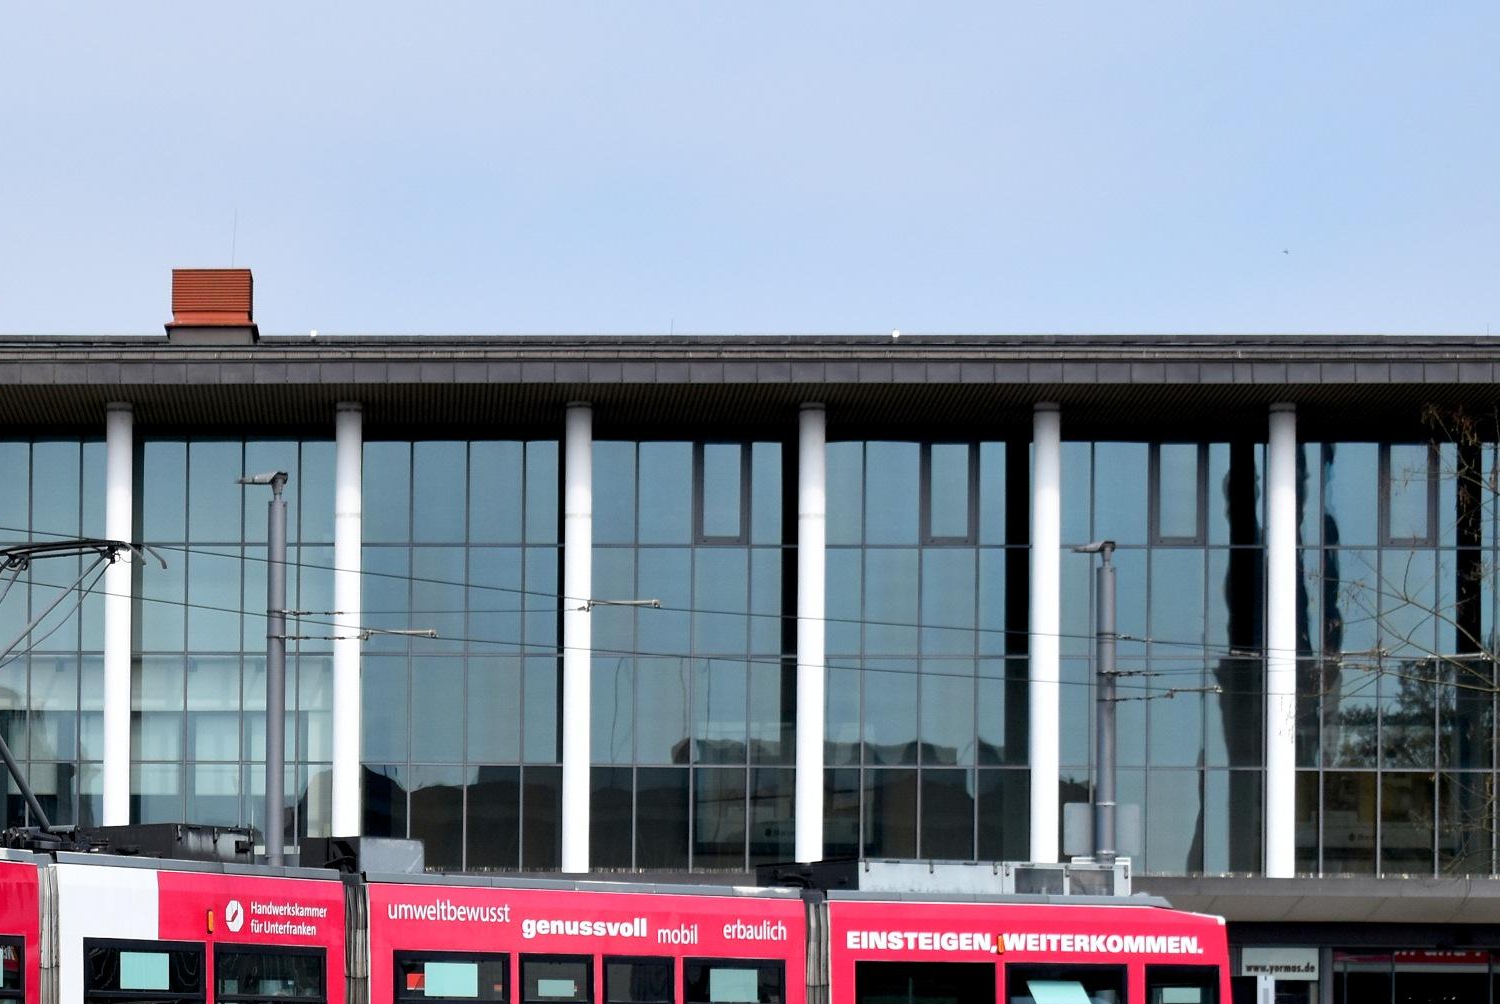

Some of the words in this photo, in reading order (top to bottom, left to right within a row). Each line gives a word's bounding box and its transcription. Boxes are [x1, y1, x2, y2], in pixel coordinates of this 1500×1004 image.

[251, 901, 327, 918] Handwerkskammer
[388, 899, 510, 923] umweltbewusst
[251, 919, 263, 933] für
[264, 921, 317, 936] Unterfranken
[522, 918, 647, 939] genussvoll
[657, 924, 698, 944] mobil
[723, 919, 787, 940] erbaulich
[846, 931, 997, 953] EINSTEIGEN,
[1002, 933, 1203, 954] WEITERKOMMEN.
[1245, 962, 1316, 974] www.yormas.de
